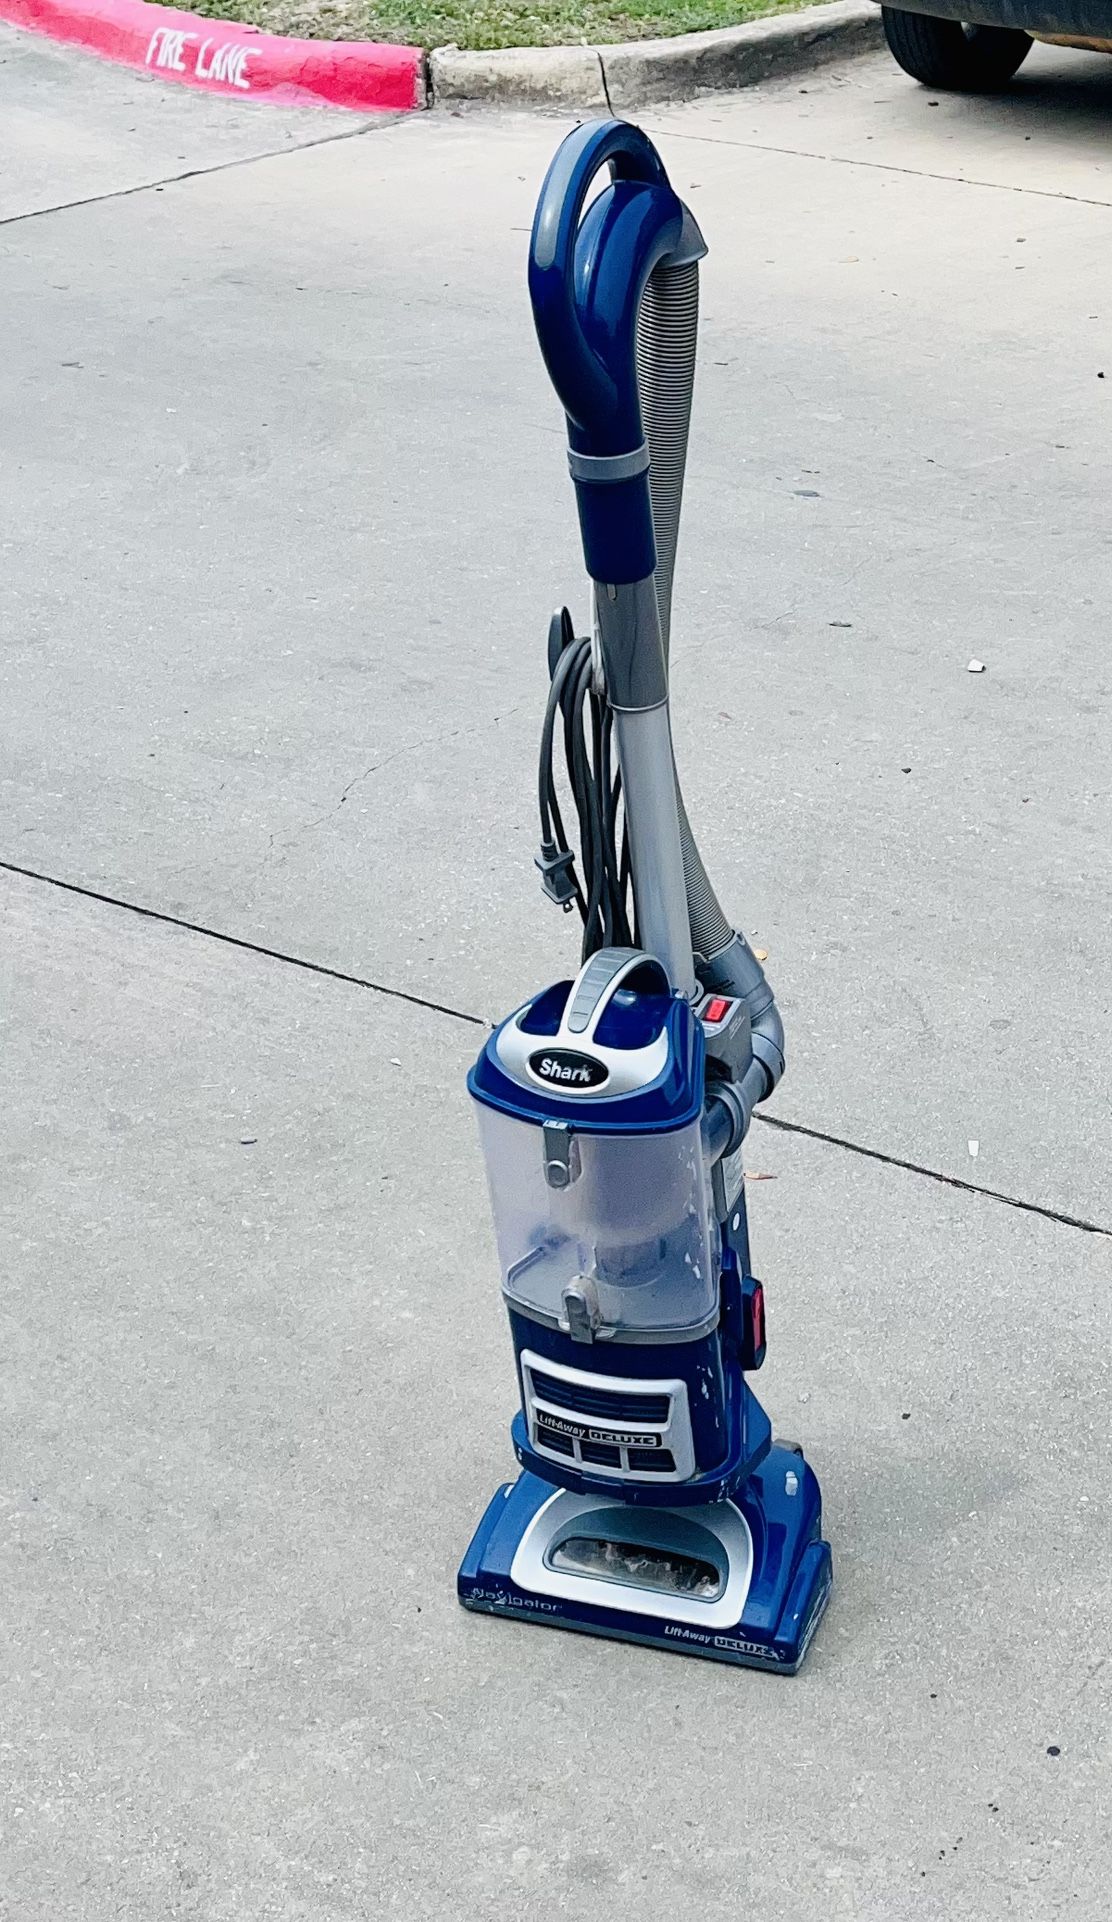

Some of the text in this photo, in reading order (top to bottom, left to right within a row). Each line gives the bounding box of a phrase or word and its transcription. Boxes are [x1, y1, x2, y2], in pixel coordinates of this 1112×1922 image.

[145, 27, 263, 89] FIRE LANE
[539, 1057, 592, 1082] Shark
[539, 1413, 656, 1446] Lift-Away DELUXE
[664, 1625, 776, 1657] Lift-Away DELUXE
